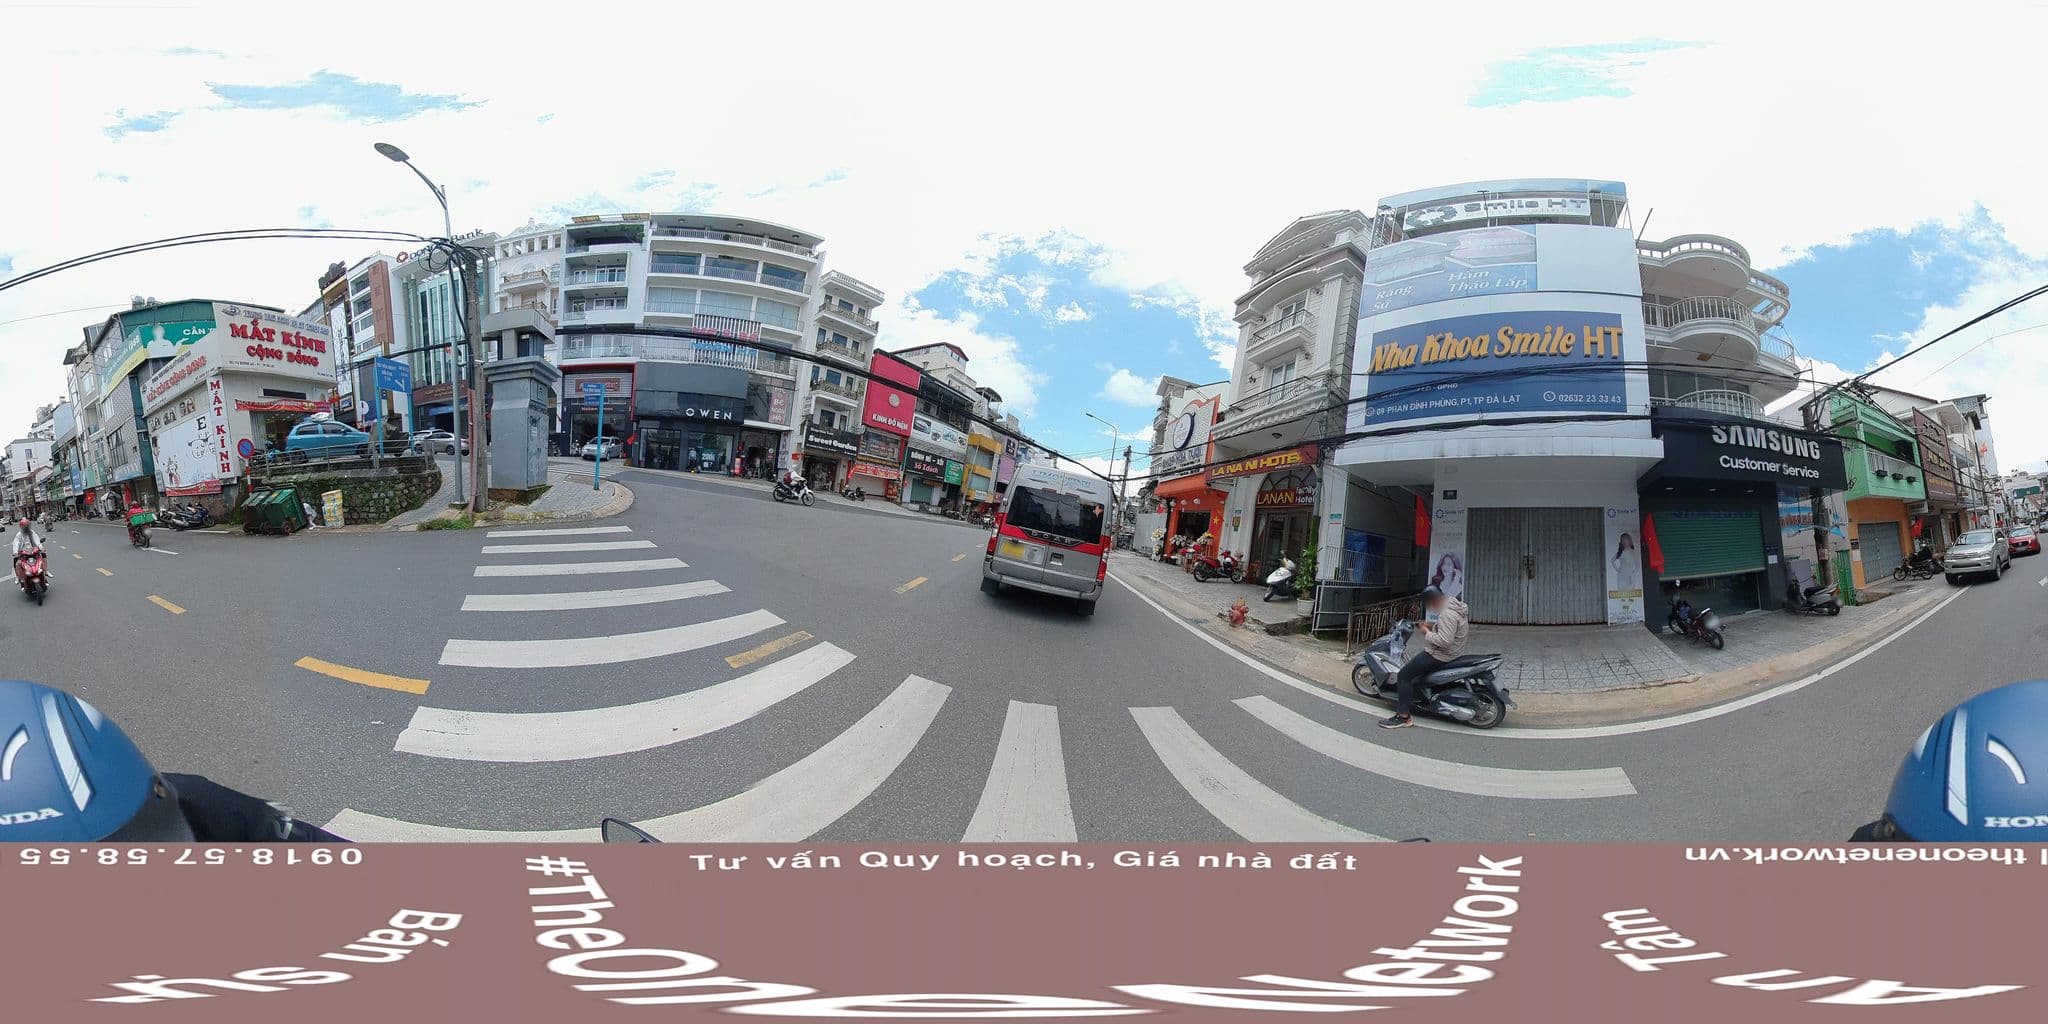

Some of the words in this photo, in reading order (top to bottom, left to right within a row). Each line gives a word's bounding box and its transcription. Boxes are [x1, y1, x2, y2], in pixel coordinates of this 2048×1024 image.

[229, 317, 276, 342] MẮT
[281, 331, 327, 353] KÍNH
[246, 343, 284, 361] CỘNG
[1367, 341, 1419, 374] Nha
[1421, 332, 1491, 364] Khoa
[1493, 324, 1576, 357] Smile
[1583, 325, 1624, 358] HT
[1387, 404, 1408, 414] PHAN
[1473, 396, 1485, 405] TP
[1558, 394, 1584, 402] 02632
[1586, 394, 1597, 402] 23
[1598, 395, 1609, 403] 33
[1611, 395, 1622, 404] 43
[685, 407, 732, 420] OWEN
[196, 416, 207, 431] E
[808, 435, 833, 446] Sweet
[833, 441, 857, 452] Garden
[1712, 425, 1821, 460] SAMSUNG
[1211, 467, 1225, 476] LA
[1226, 463, 1243, 474] NA
[1244, 459, 1258, 471] NI
[1259, 451, 1302, 468] HOTEL
[1719, 455, 1781, 473] Customer
[1782, 462, 1820, 479] Service
[1257, 491, 1295, 505] LANANI
[1295, 495, 1315, 505] Hotel
